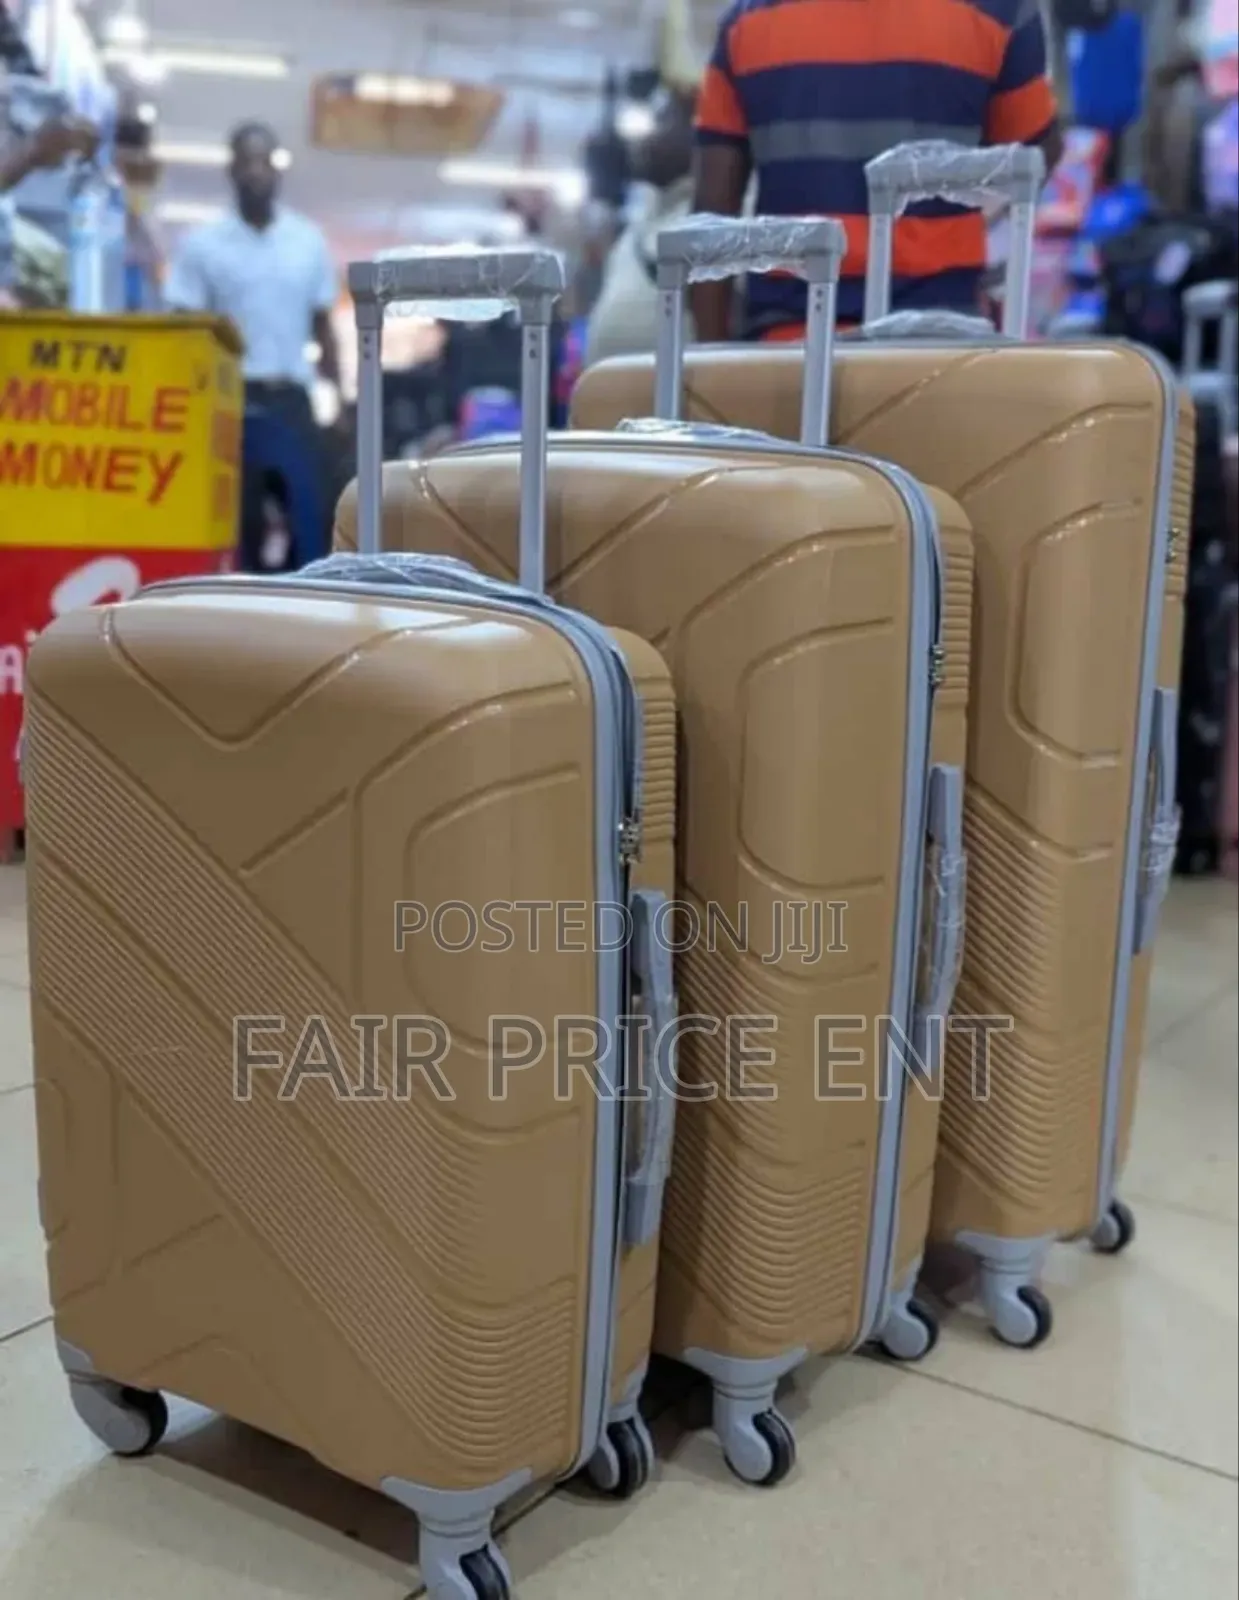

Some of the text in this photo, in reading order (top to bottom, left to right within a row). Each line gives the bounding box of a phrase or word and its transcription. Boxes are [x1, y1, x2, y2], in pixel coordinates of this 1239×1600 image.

[30, 339, 128, 374] MTN
[0, 375, 191, 433] MOBILE
[0, 438, 184, 505] MONEY
